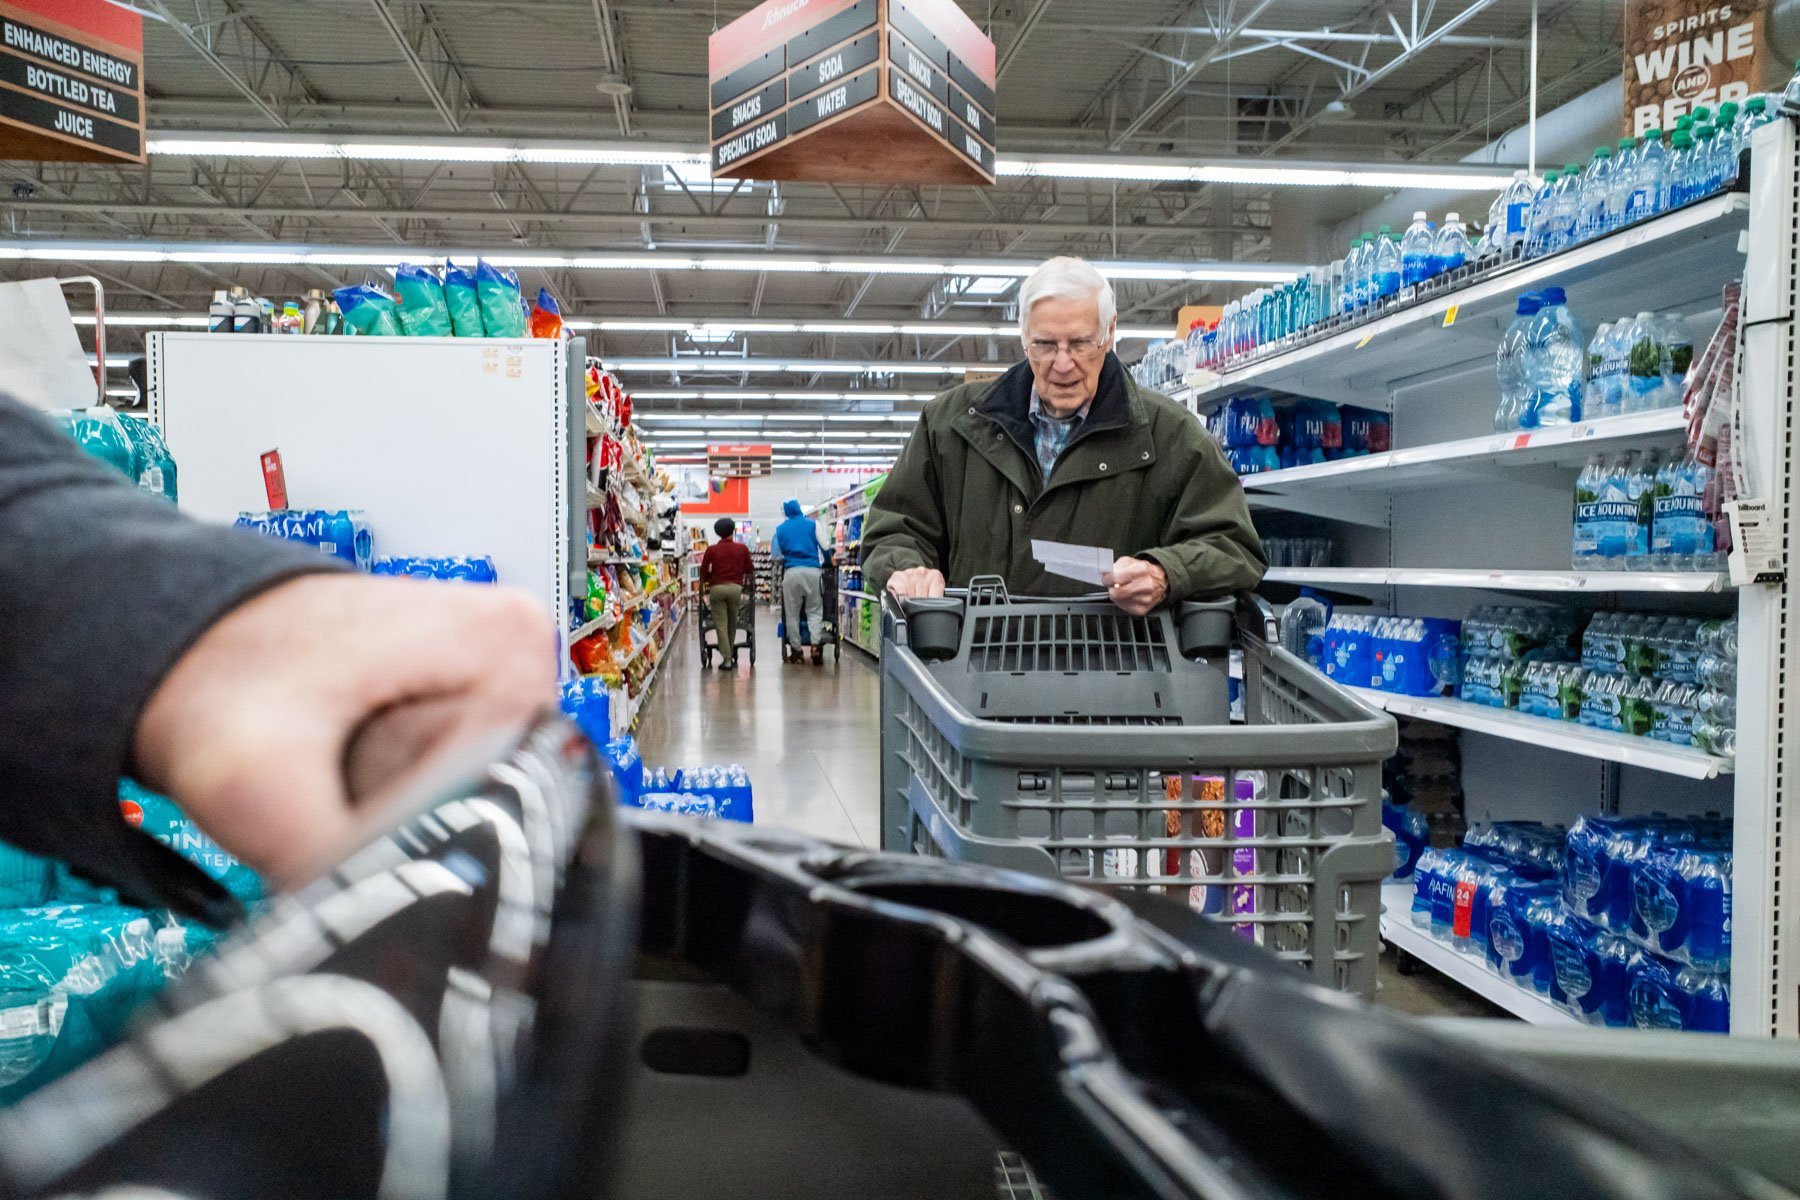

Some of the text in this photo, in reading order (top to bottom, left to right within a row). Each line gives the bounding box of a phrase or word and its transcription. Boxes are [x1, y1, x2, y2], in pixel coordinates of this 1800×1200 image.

[761, 0, 809, 31] Schnuc
[1653, 4, 1732, 40] SPIRITS
[4, 22, 131, 85] ENHANCED ENERGY
[819, 53, 843, 83] SODA
[1634, 22, 1754, 85] WINE
[908, 53, 931, 89] SNACKS
[1677, 73, 1706, 91] AND
[27, 66, 116, 113] BOTTLED TEA
[817, 87, 846, 118] WATER
[732, 95, 761, 127] SNACKS
[897, 78, 942, 132] SPECIALTY SODA
[966, 103, 980, 131] SODA
[54, 110, 94, 139] JUICE
[719, 121, 777, 165] SPECIALTY SODA
[965, 133, 981, 163] WATER
[1306, 420, 1324, 434] FIJI
[1351, 421, 1369, 435] FIJI
[1580, 505, 1596, 517] ICE
[1655, 500, 1671, 512] ICE
[259, 518, 325, 539] DASANI
[189, 852, 239, 867] ATER
[1456, 889, 1470, 901] 24
